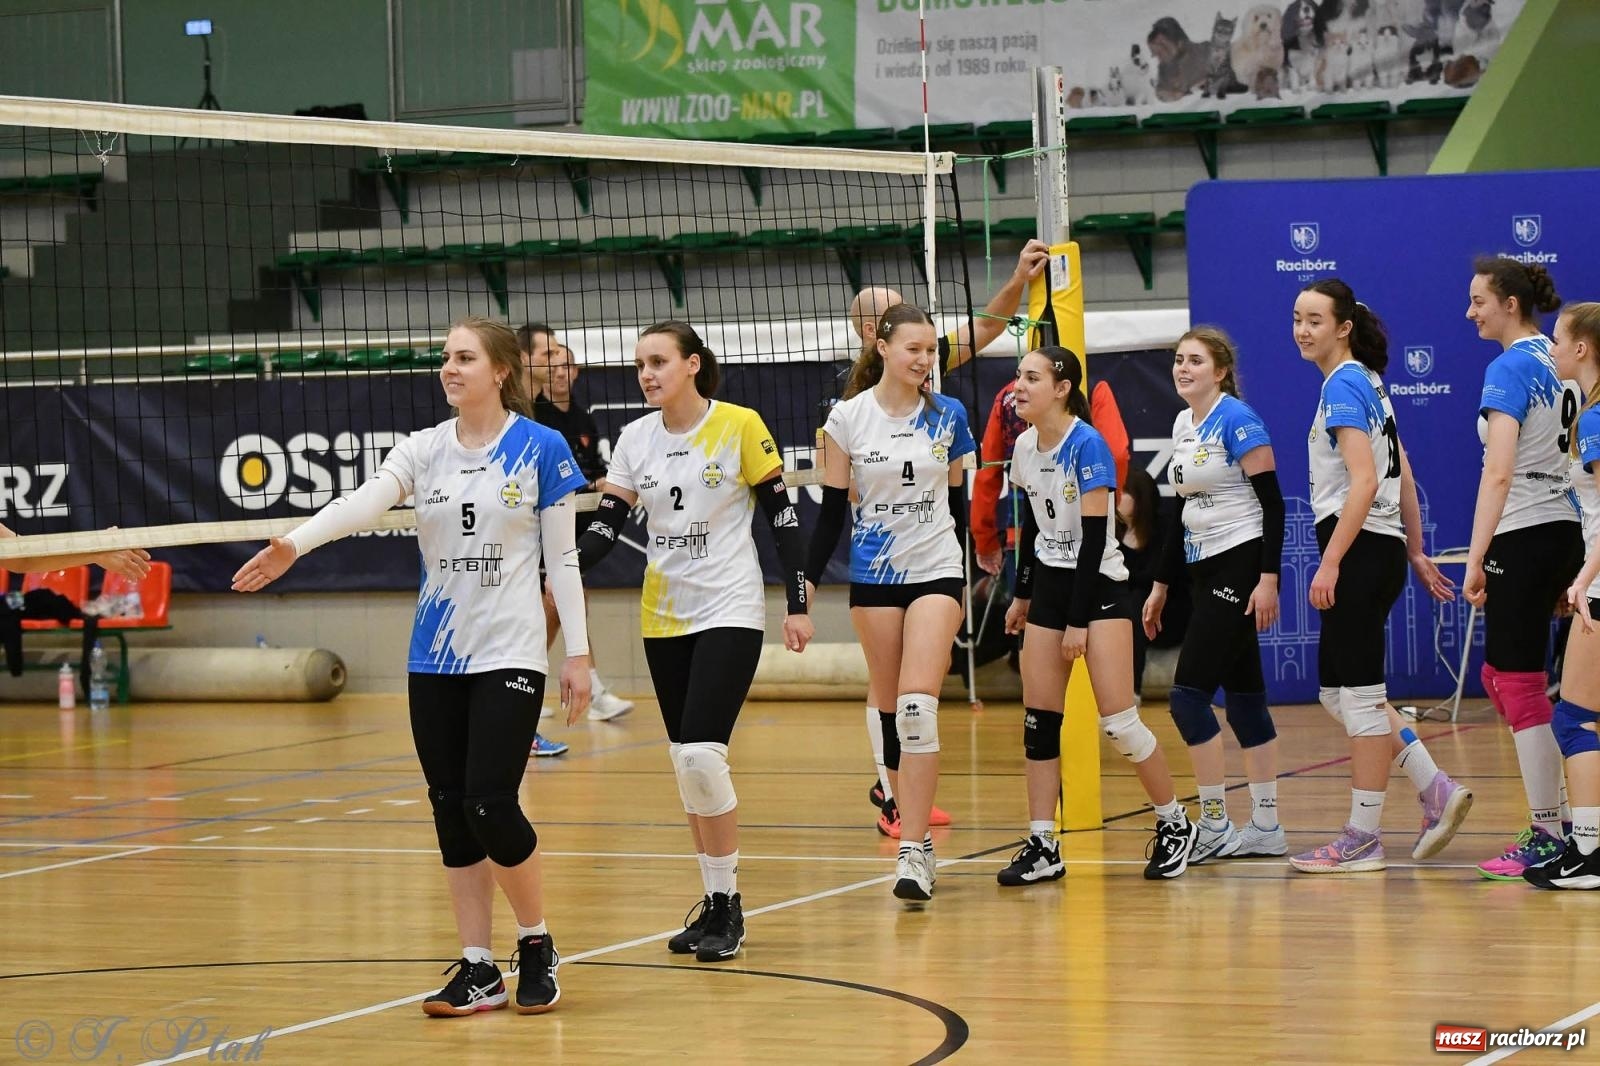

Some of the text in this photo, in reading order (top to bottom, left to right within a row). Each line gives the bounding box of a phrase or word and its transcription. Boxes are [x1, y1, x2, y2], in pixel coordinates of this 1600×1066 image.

[685, 3, 827, 54] MAR
[687, 53, 828, 75] sklep zoologiczny
[935, 60, 952, 77] od
[957, 57, 990, 76] 1989
[621, 90, 829, 126] WWW.ZOO-MAR.PL
[1276, 258, 1337, 272] Racibórz
[1390, 382, 1451, 396] Racibórz
[1557, 388, 1578, 454] 9
[902, 461, 915, 481] 4
[1173, 464, 1184, 484] 16
[670, 486, 684, 511] 2
[462, 503, 476, 530] 5
[1045, 498, 1056, 520] 8
[1212, 588, 1240, 603] VOLLEY
[1223, 586, 1234, 594] PV
[505, 680, 535, 694] VOLLEY
[517, 676, 528, 684] PV
